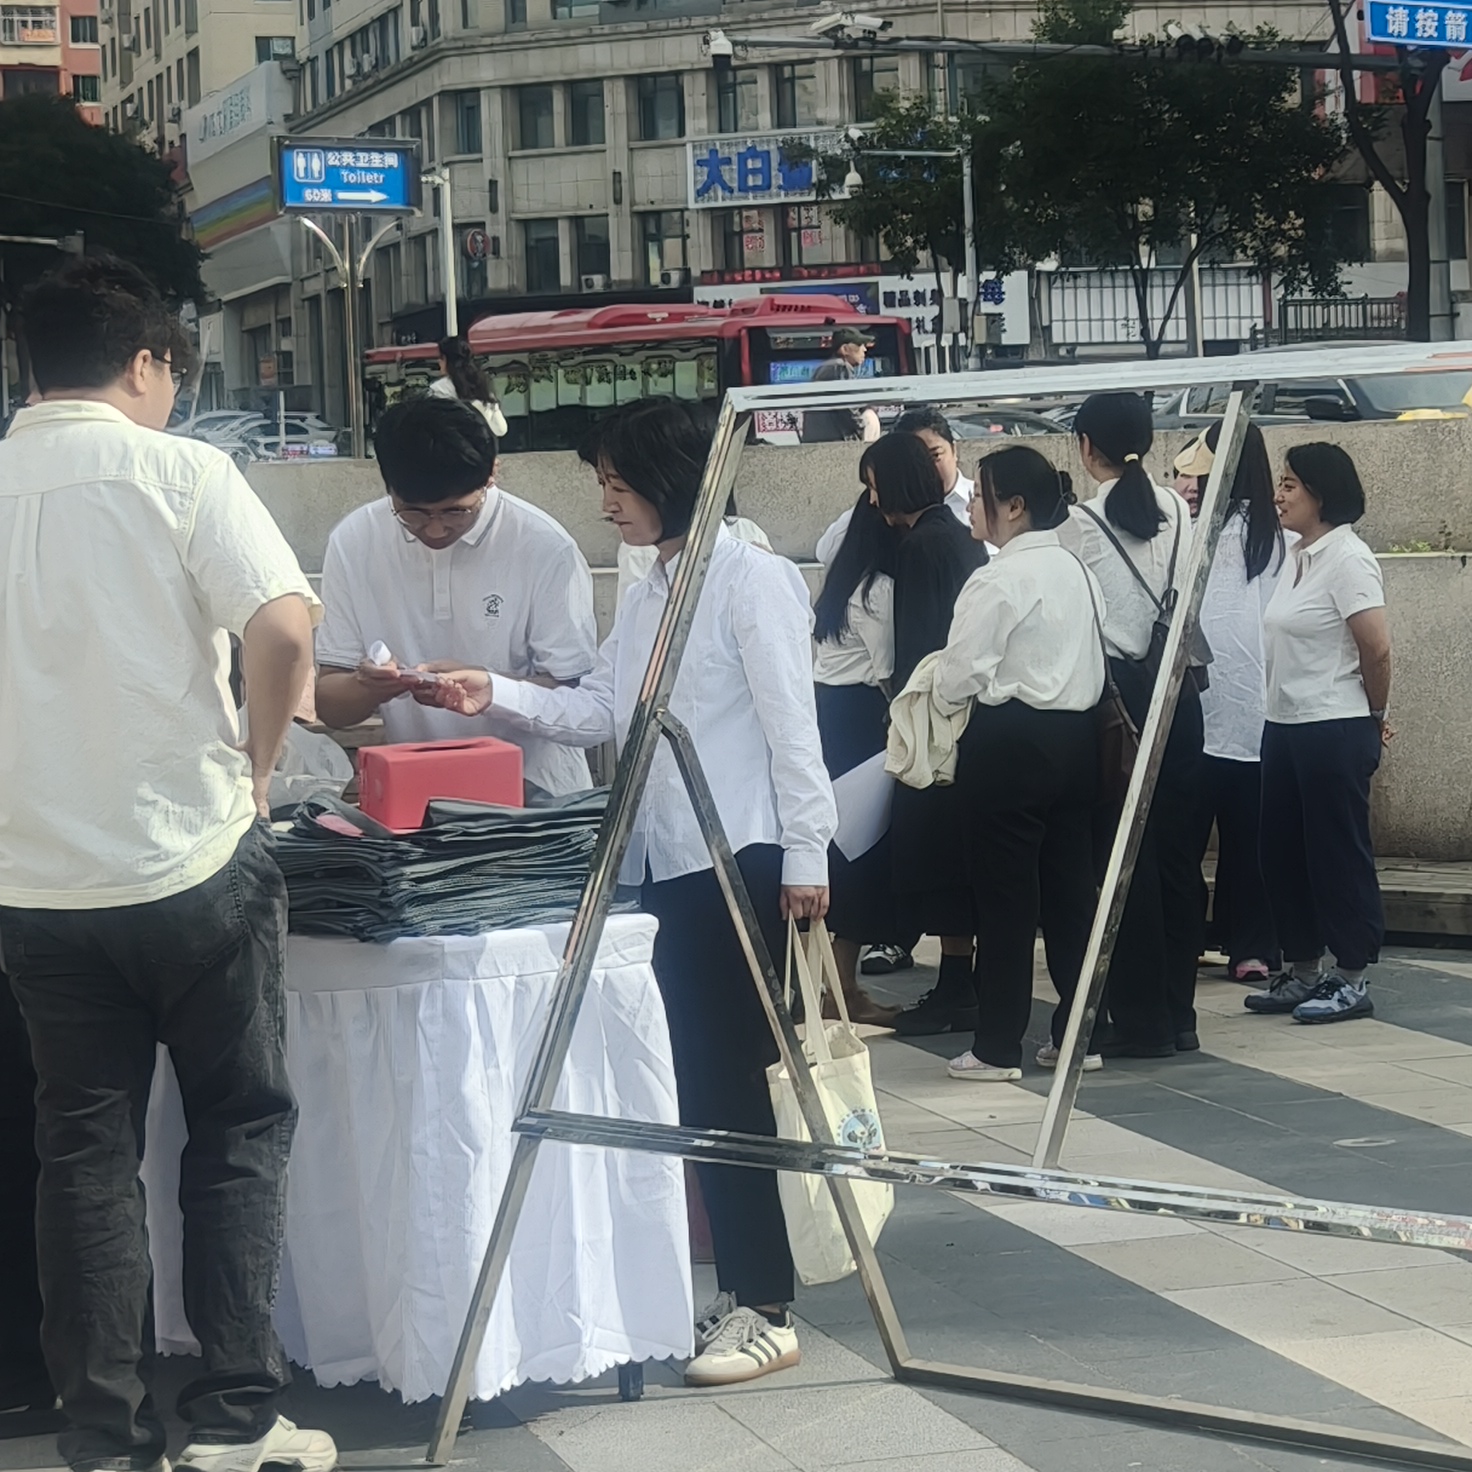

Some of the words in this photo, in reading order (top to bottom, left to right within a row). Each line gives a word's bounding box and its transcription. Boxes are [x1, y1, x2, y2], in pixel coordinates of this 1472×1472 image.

[327, 151, 399, 169] 公共卫生间
